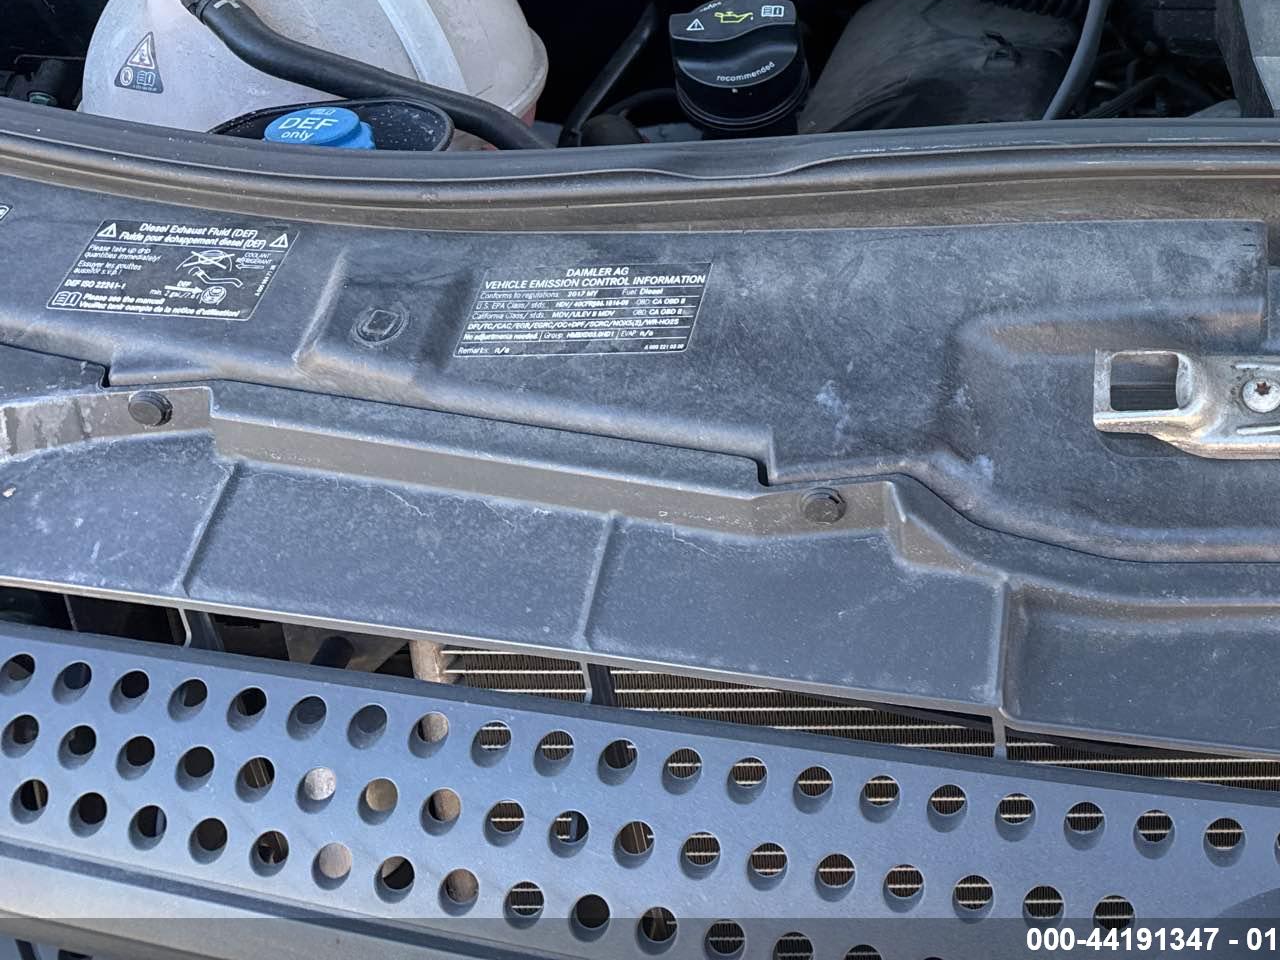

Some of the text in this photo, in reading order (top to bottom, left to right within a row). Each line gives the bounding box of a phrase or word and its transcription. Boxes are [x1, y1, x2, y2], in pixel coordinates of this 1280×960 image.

[716, 61, 776, 82] recommended
[278, 117, 339, 130] DEF
[281, 130, 315, 142] only
[139, 223, 259, 239] Diesel Exhaust Fluid (DEF)
[119, 231, 267, 250] Fluide pour échappement diesel (DEF)
[88, 244, 111, 252] Please
[244, 251, 272, 259] COOLANT
[566, 266, 630, 278] DAIMLER AG
[64, 279, 81, 288] DEF
[80, 280, 95, 288] ISO
[485, 274, 706, 290] VEHICLE EMISSION CONTROL INFORMATION
[480, 292, 512, 300] Conforms
[567, 290, 586, 298] 2017
[586, 289, 599, 297] MY
[639, 287, 664, 296] Diesel
[82, 293, 107, 302] Please
[122, 295, 135, 303] the
[663, 297, 680, 305] OBD
[491, 301, 506, 310] EPA
[472, 312, 504, 320] California
[597, 310, 616, 318] MDV
[494, 346, 510, 355] n/a
